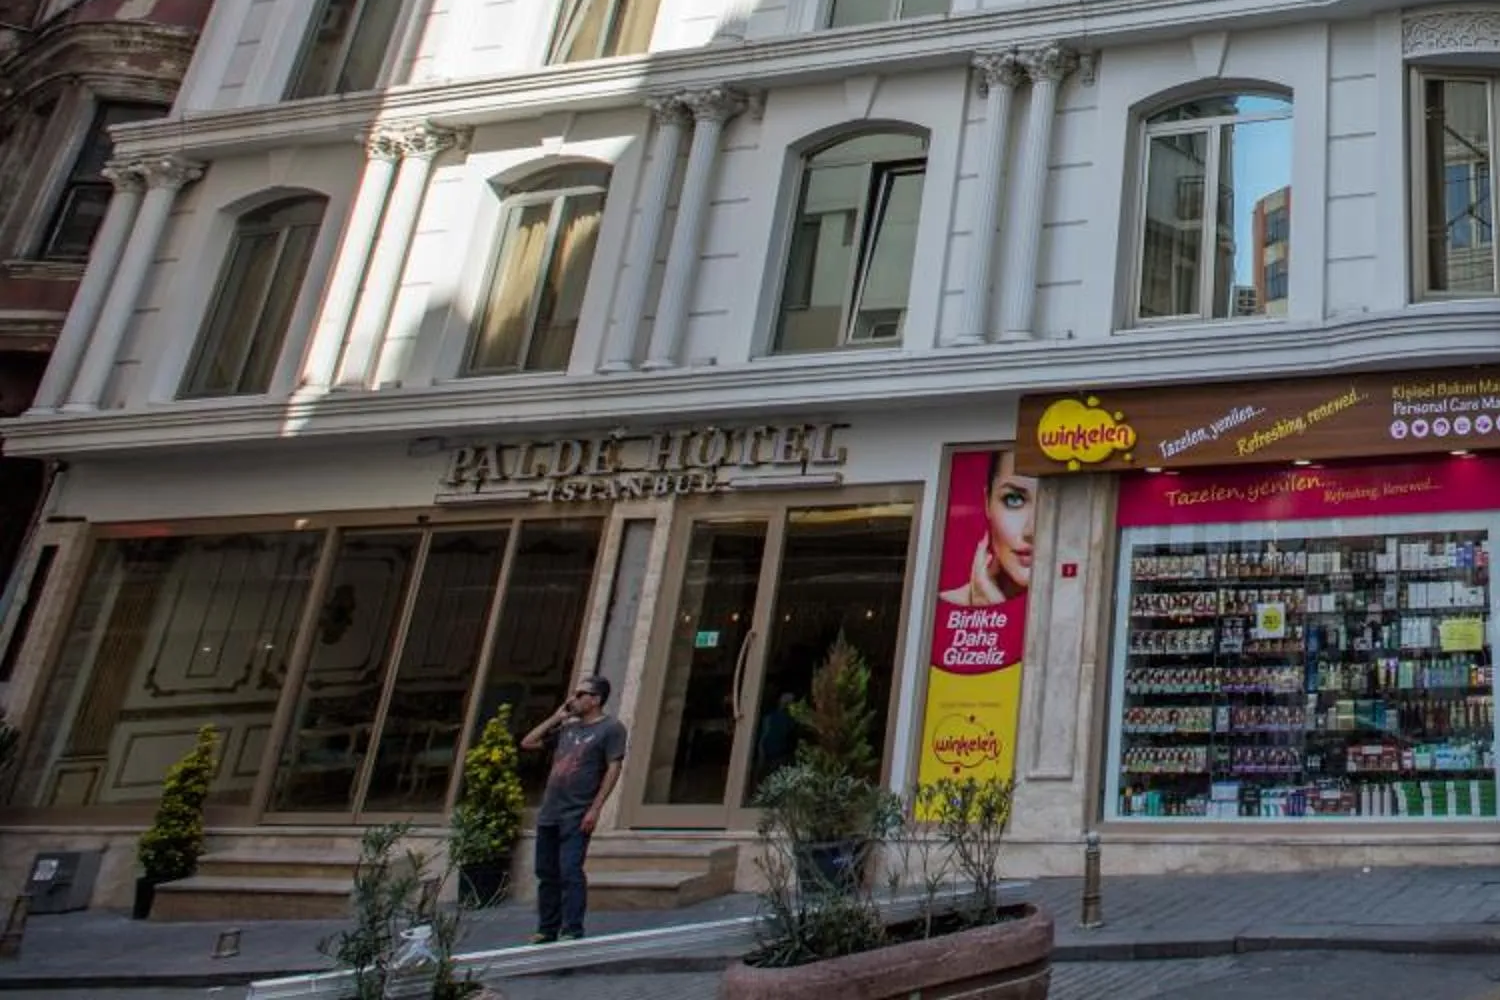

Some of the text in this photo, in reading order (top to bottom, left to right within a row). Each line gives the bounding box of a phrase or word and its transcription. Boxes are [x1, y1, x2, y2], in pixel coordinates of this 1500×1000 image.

[1392, 399, 1448, 416] Personal
[1450, 396, 1479, 411] Care
[1041, 423, 1131, 451] winkelen
[443, 424, 847, 483] PALDE HOTEL
[1166, 484, 1245, 508] Tazelen,
[946, 610, 1008, 629] Birlikte
[953, 630, 998, 647] Daha
[943, 646, 1005, 665] Güzeliz
[934, 734, 999, 758] winkelen
